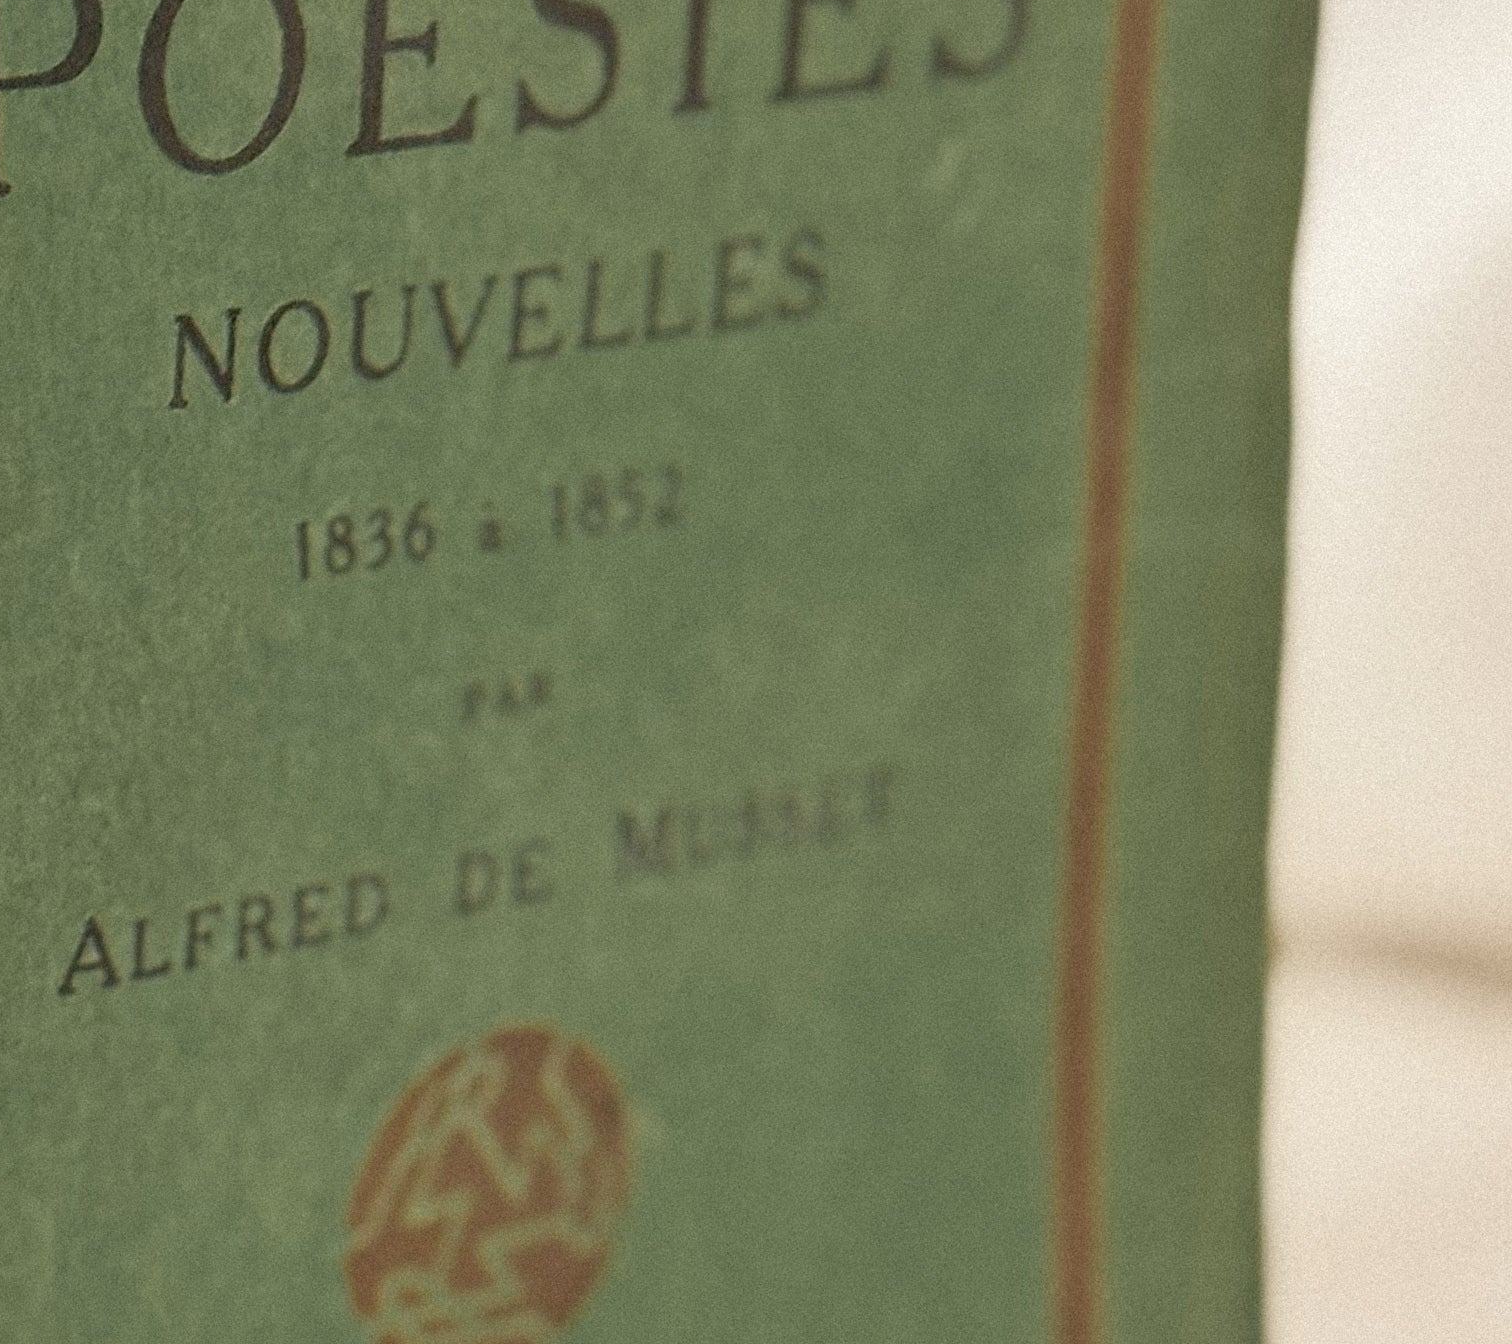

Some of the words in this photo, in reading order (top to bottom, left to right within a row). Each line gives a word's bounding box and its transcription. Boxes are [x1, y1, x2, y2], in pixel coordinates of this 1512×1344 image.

[166, 227, 831, 411] NOUVELLES
[295, 498, 437, 582] 1836
[550, 465, 685, 541] 1852
[56, 872, 391, 996] ALFRED
[451, 837, 556, 920] DE
